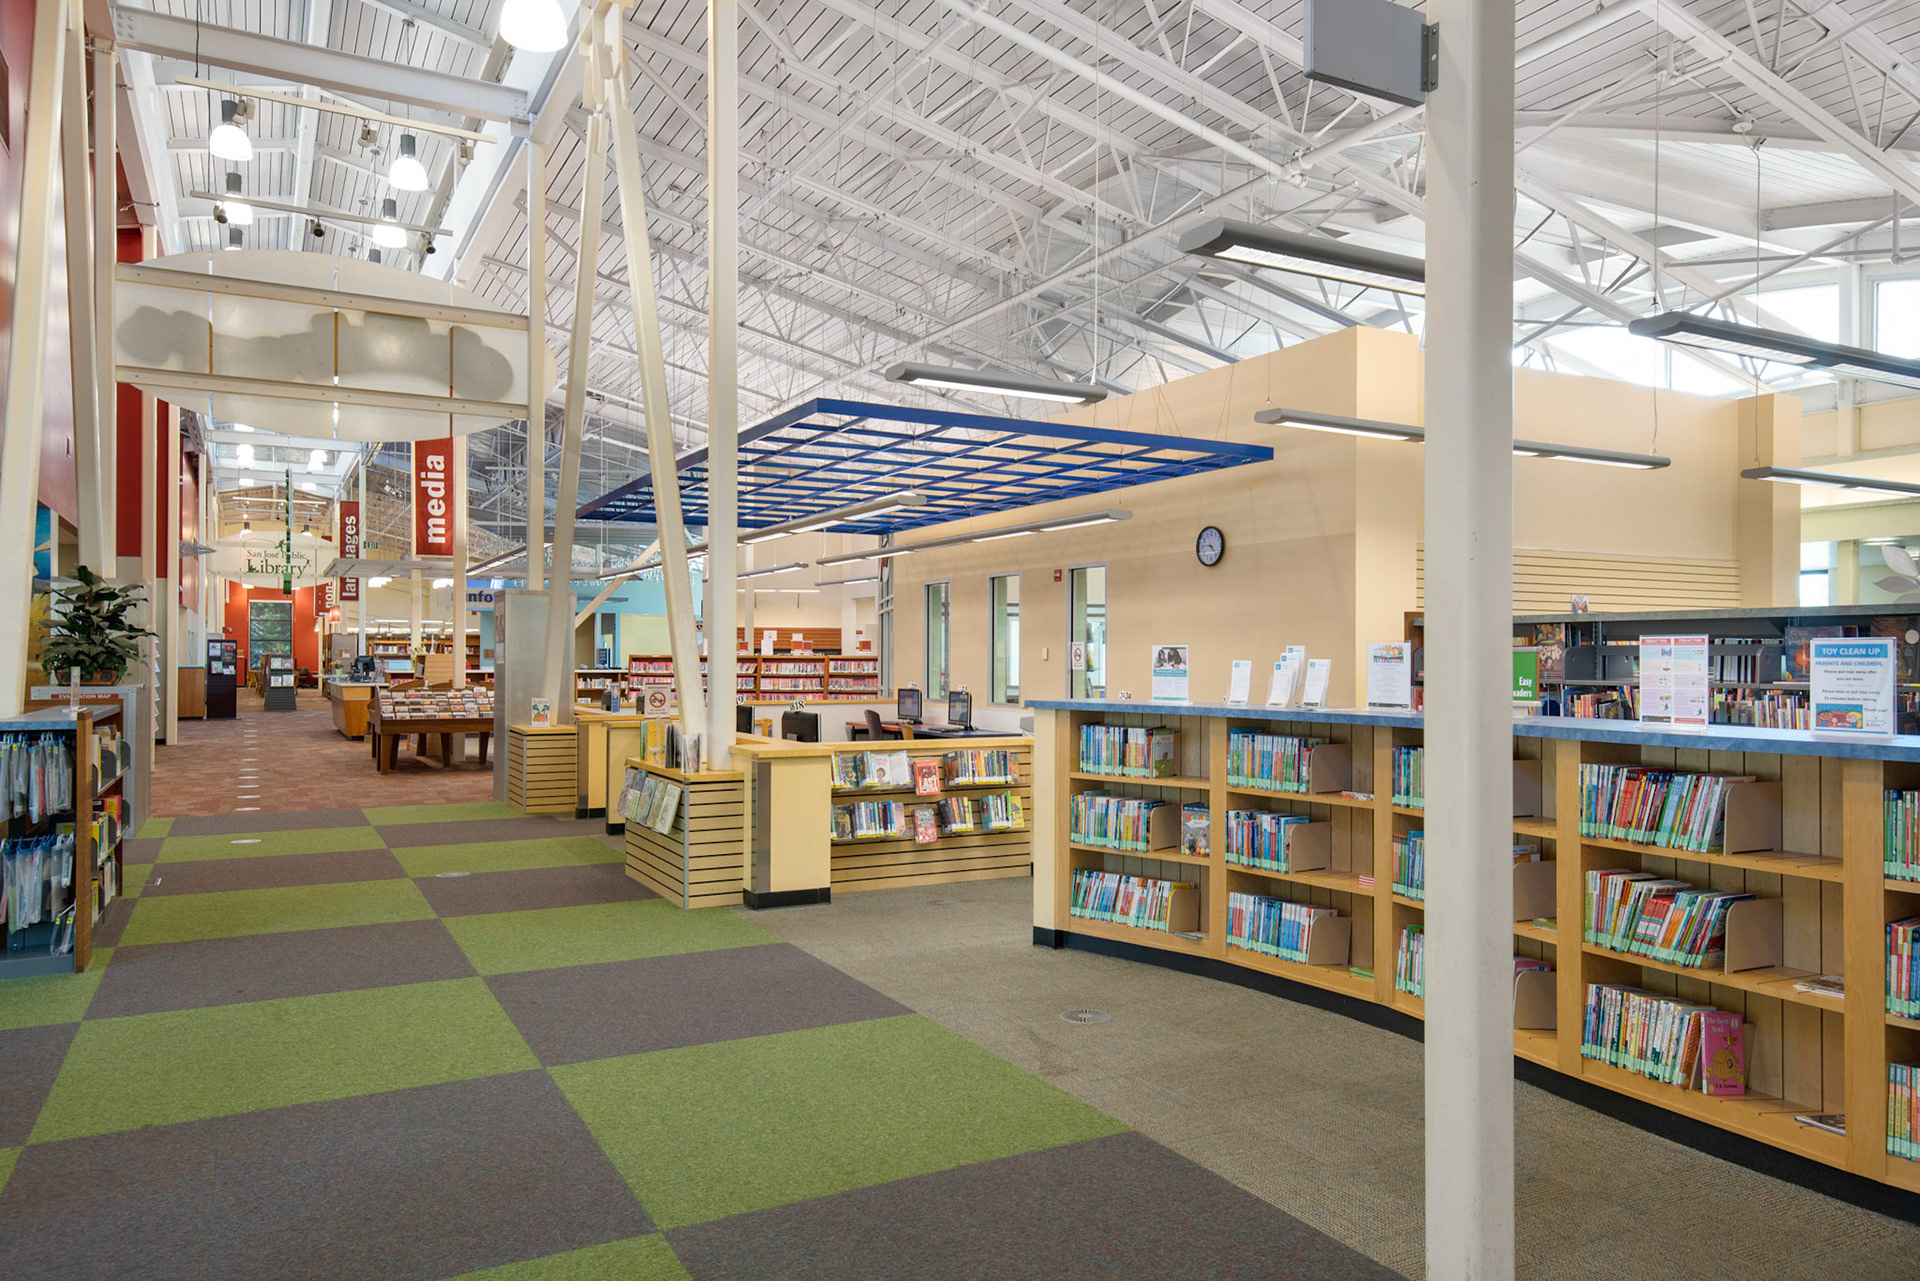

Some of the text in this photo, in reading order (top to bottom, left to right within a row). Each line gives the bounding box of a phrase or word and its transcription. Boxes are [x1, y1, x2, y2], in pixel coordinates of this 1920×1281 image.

[420, 454, 446, 544] media
[246, 550, 307, 559] San José Pblic
[246, 558, 306, 579] Library
[466, 590, 494, 603] nfo
[1822, 647, 1838, 655] TOY
[1839, 647, 1867, 655] CLEAN
[1519, 676, 1533, 687] Easy
[1512, 689, 1533, 698] eaders
